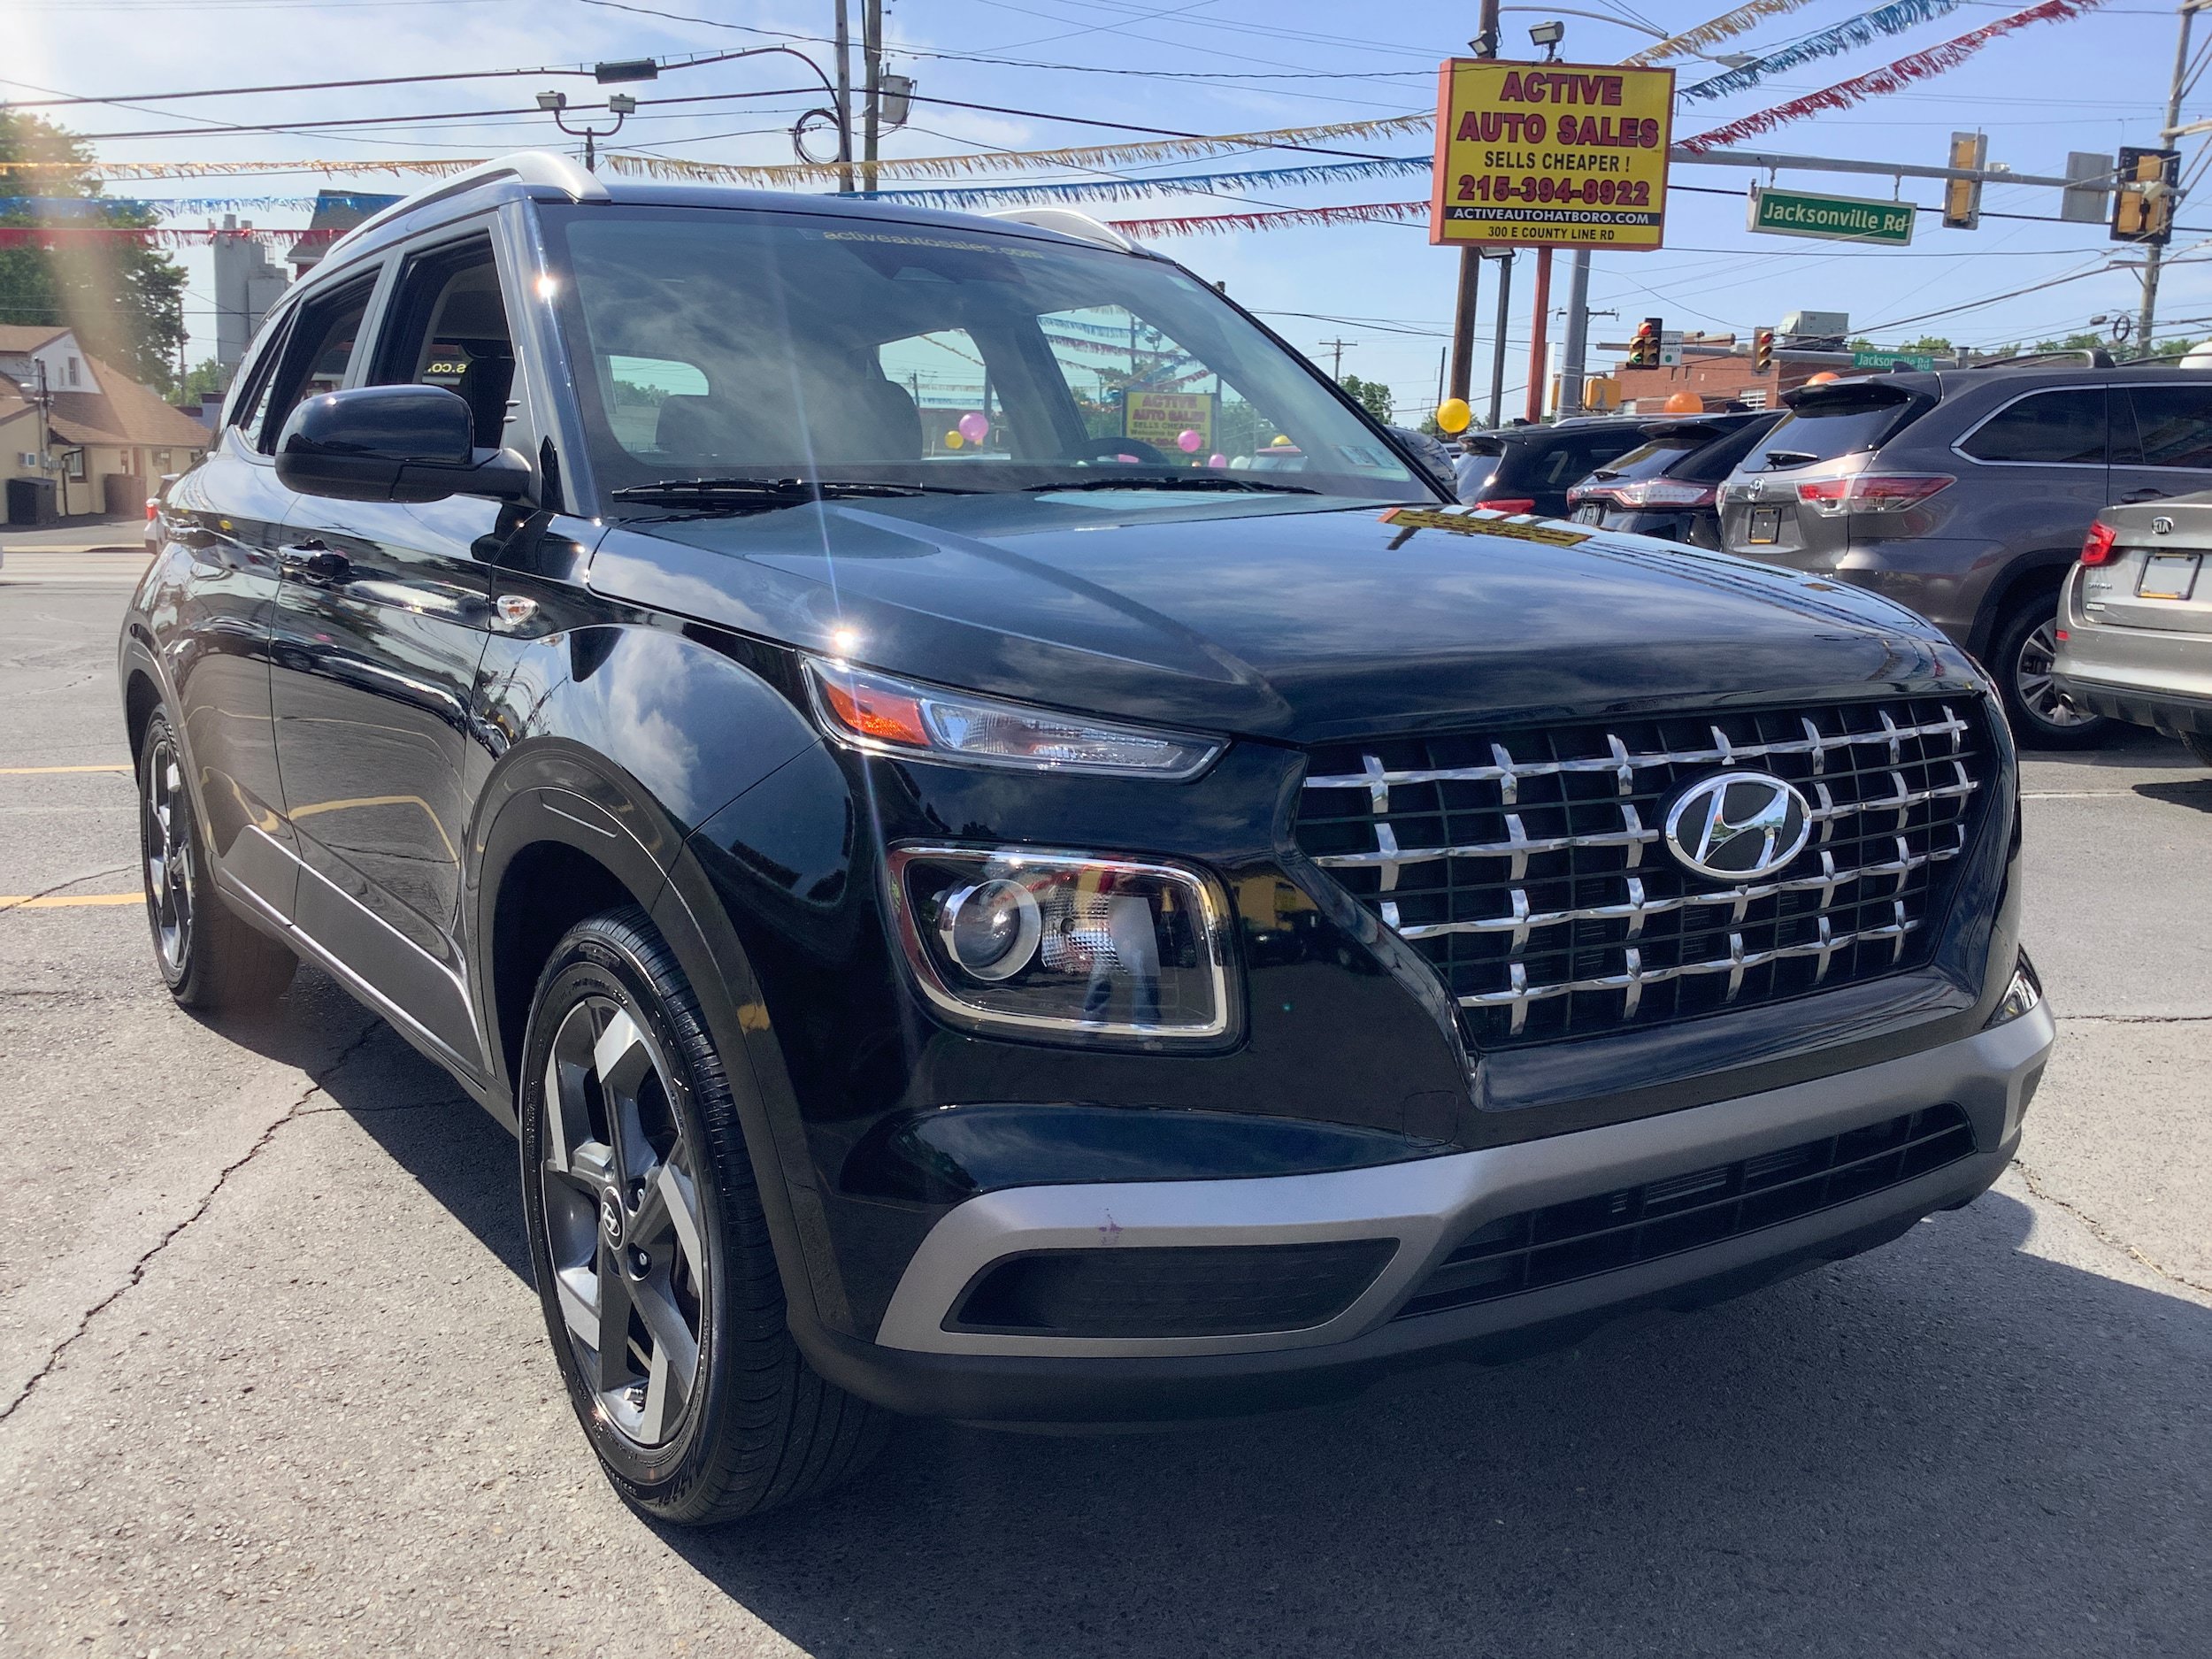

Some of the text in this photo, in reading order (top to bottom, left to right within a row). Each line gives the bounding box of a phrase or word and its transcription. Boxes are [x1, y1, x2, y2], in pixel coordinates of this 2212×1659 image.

[1499, 71, 1623, 106] ACTIVE
[1456, 111, 1659, 149] AUTO SALES
[1484, 151, 1535, 169] SELLS
[1542, 153, 1619, 173] CHEAPER
[1457, 174, 1650, 206] 215-394-8922
[1454, 208, 1649, 225] ACTIVEAUTOHATBORO.COM
[1763, 202, 1907, 232] Jacksonville Rd
[1488, 226, 1615, 241] 300 E COUNTY LINE RD
[823, 230, 1044, 259] activeautosales.com
[1858, 354, 1929, 370] Jacksonille Rd
[1142, 395, 1197, 408] ACTIVE
[1133, 409, 1165, 420] AUTO
[2154, 521, 2170, 533] KIA
